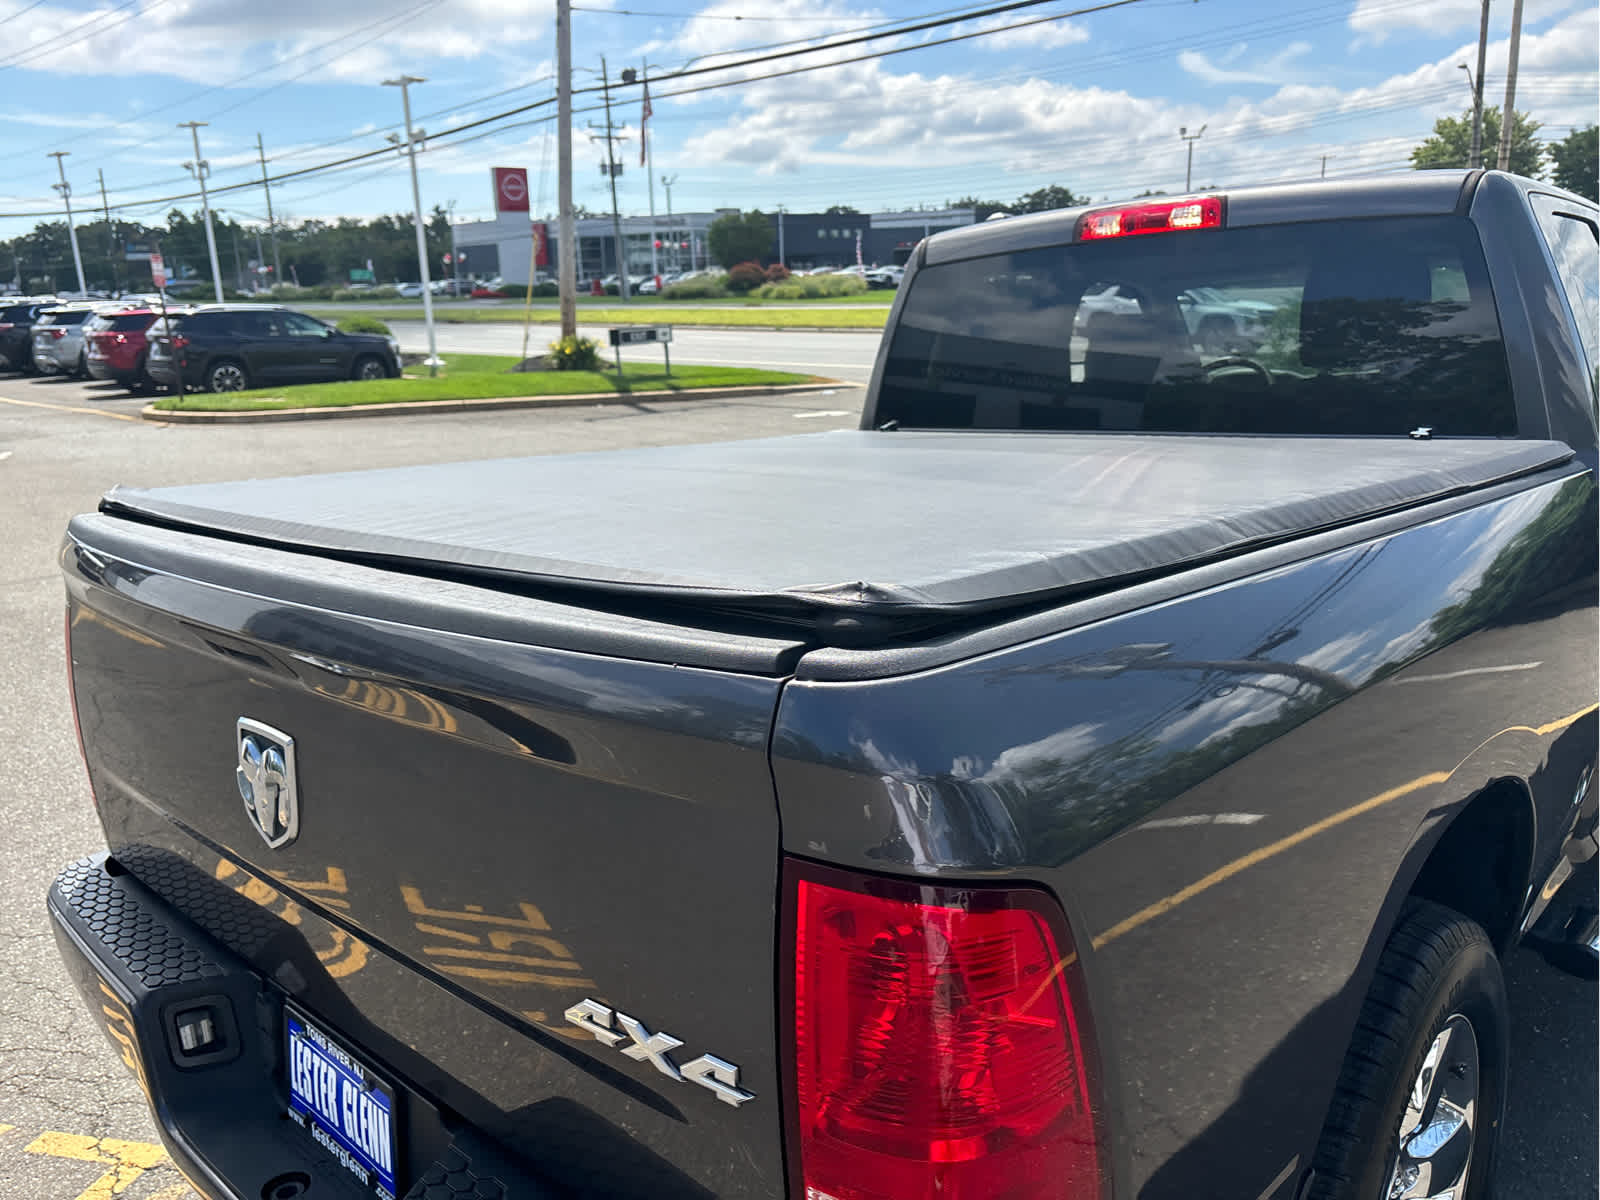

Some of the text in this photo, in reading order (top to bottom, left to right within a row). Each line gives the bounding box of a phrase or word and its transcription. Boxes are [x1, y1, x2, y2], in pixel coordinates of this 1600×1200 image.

[306, 1024, 327, 1050] TOMS
[353, 1063, 364, 1080] NJ
[290, 1034, 392, 1173] LESTER GLENN
